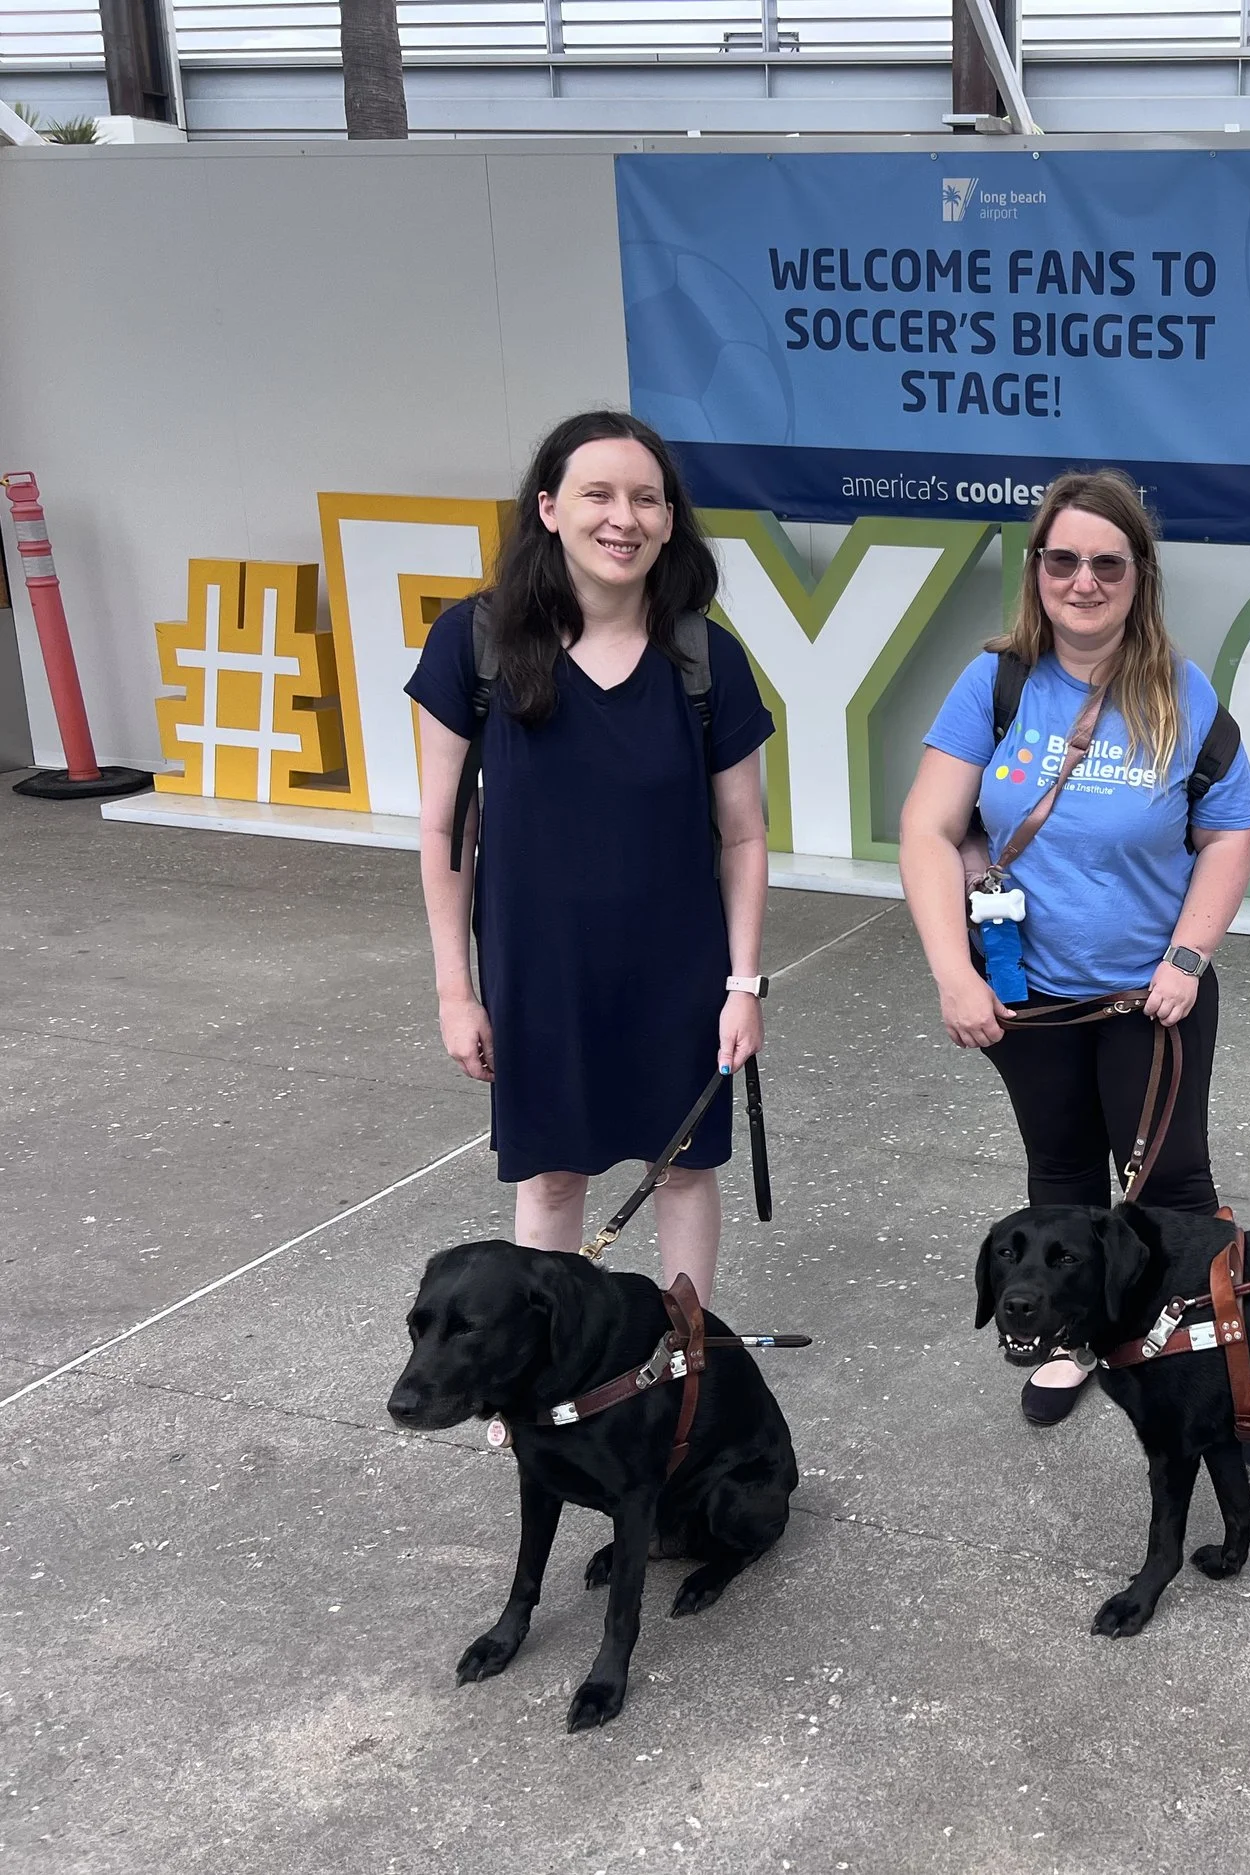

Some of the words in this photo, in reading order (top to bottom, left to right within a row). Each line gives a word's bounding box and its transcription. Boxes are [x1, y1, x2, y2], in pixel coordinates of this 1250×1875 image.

[980, 190, 1007, 206] long
[1010, 190, 1047, 204] beach
[980, 206, 1018, 222] airport
[768, 247, 992, 294] WELCOME
[1008, 249, 1136, 297] FANS
[1152, 251, 1216, 298] TO
[784, 307, 997, 355] SOCCER’S
[1013, 311, 1216, 361] BIGGEST
[901, 369, 1061, 418] STAGE!
[842, 474, 949, 501] america’s
